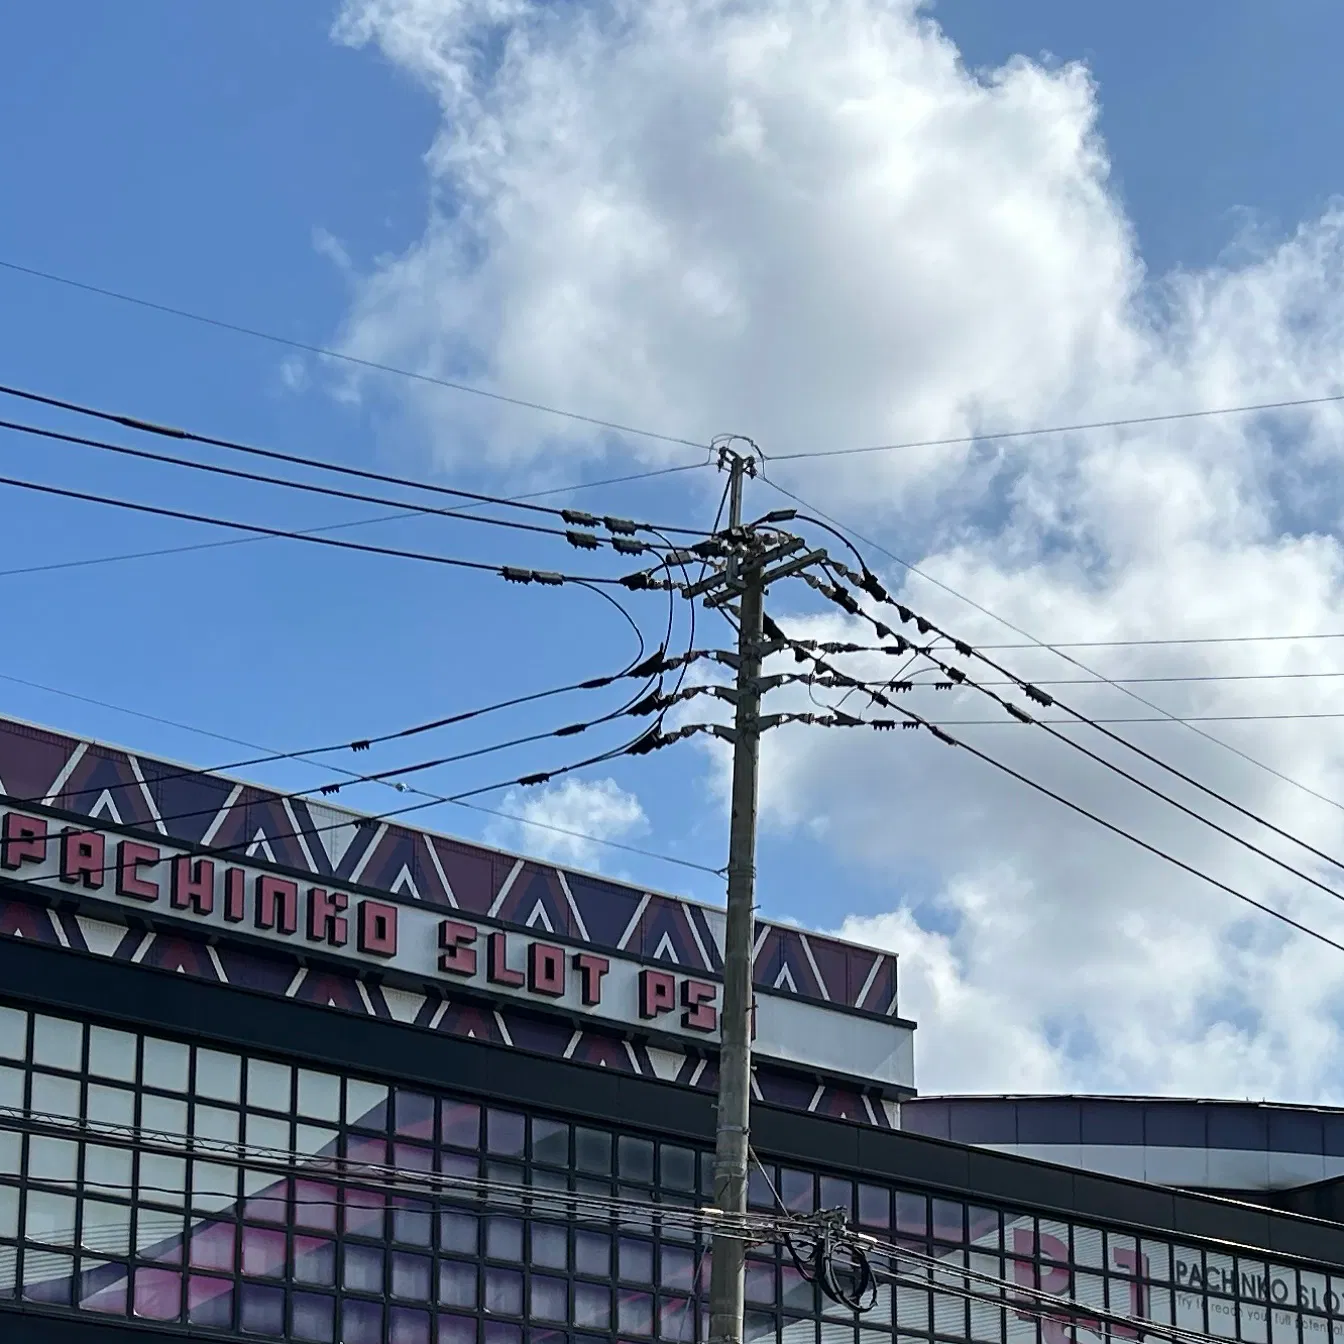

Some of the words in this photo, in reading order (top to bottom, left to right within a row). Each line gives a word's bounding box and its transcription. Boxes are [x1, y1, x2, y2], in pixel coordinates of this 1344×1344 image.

[1, 811, 398, 957] PACHINKO
[438, 919, 609, 1006] SLOT
[1176, 1260, 1289, 1304] PACHNKO
